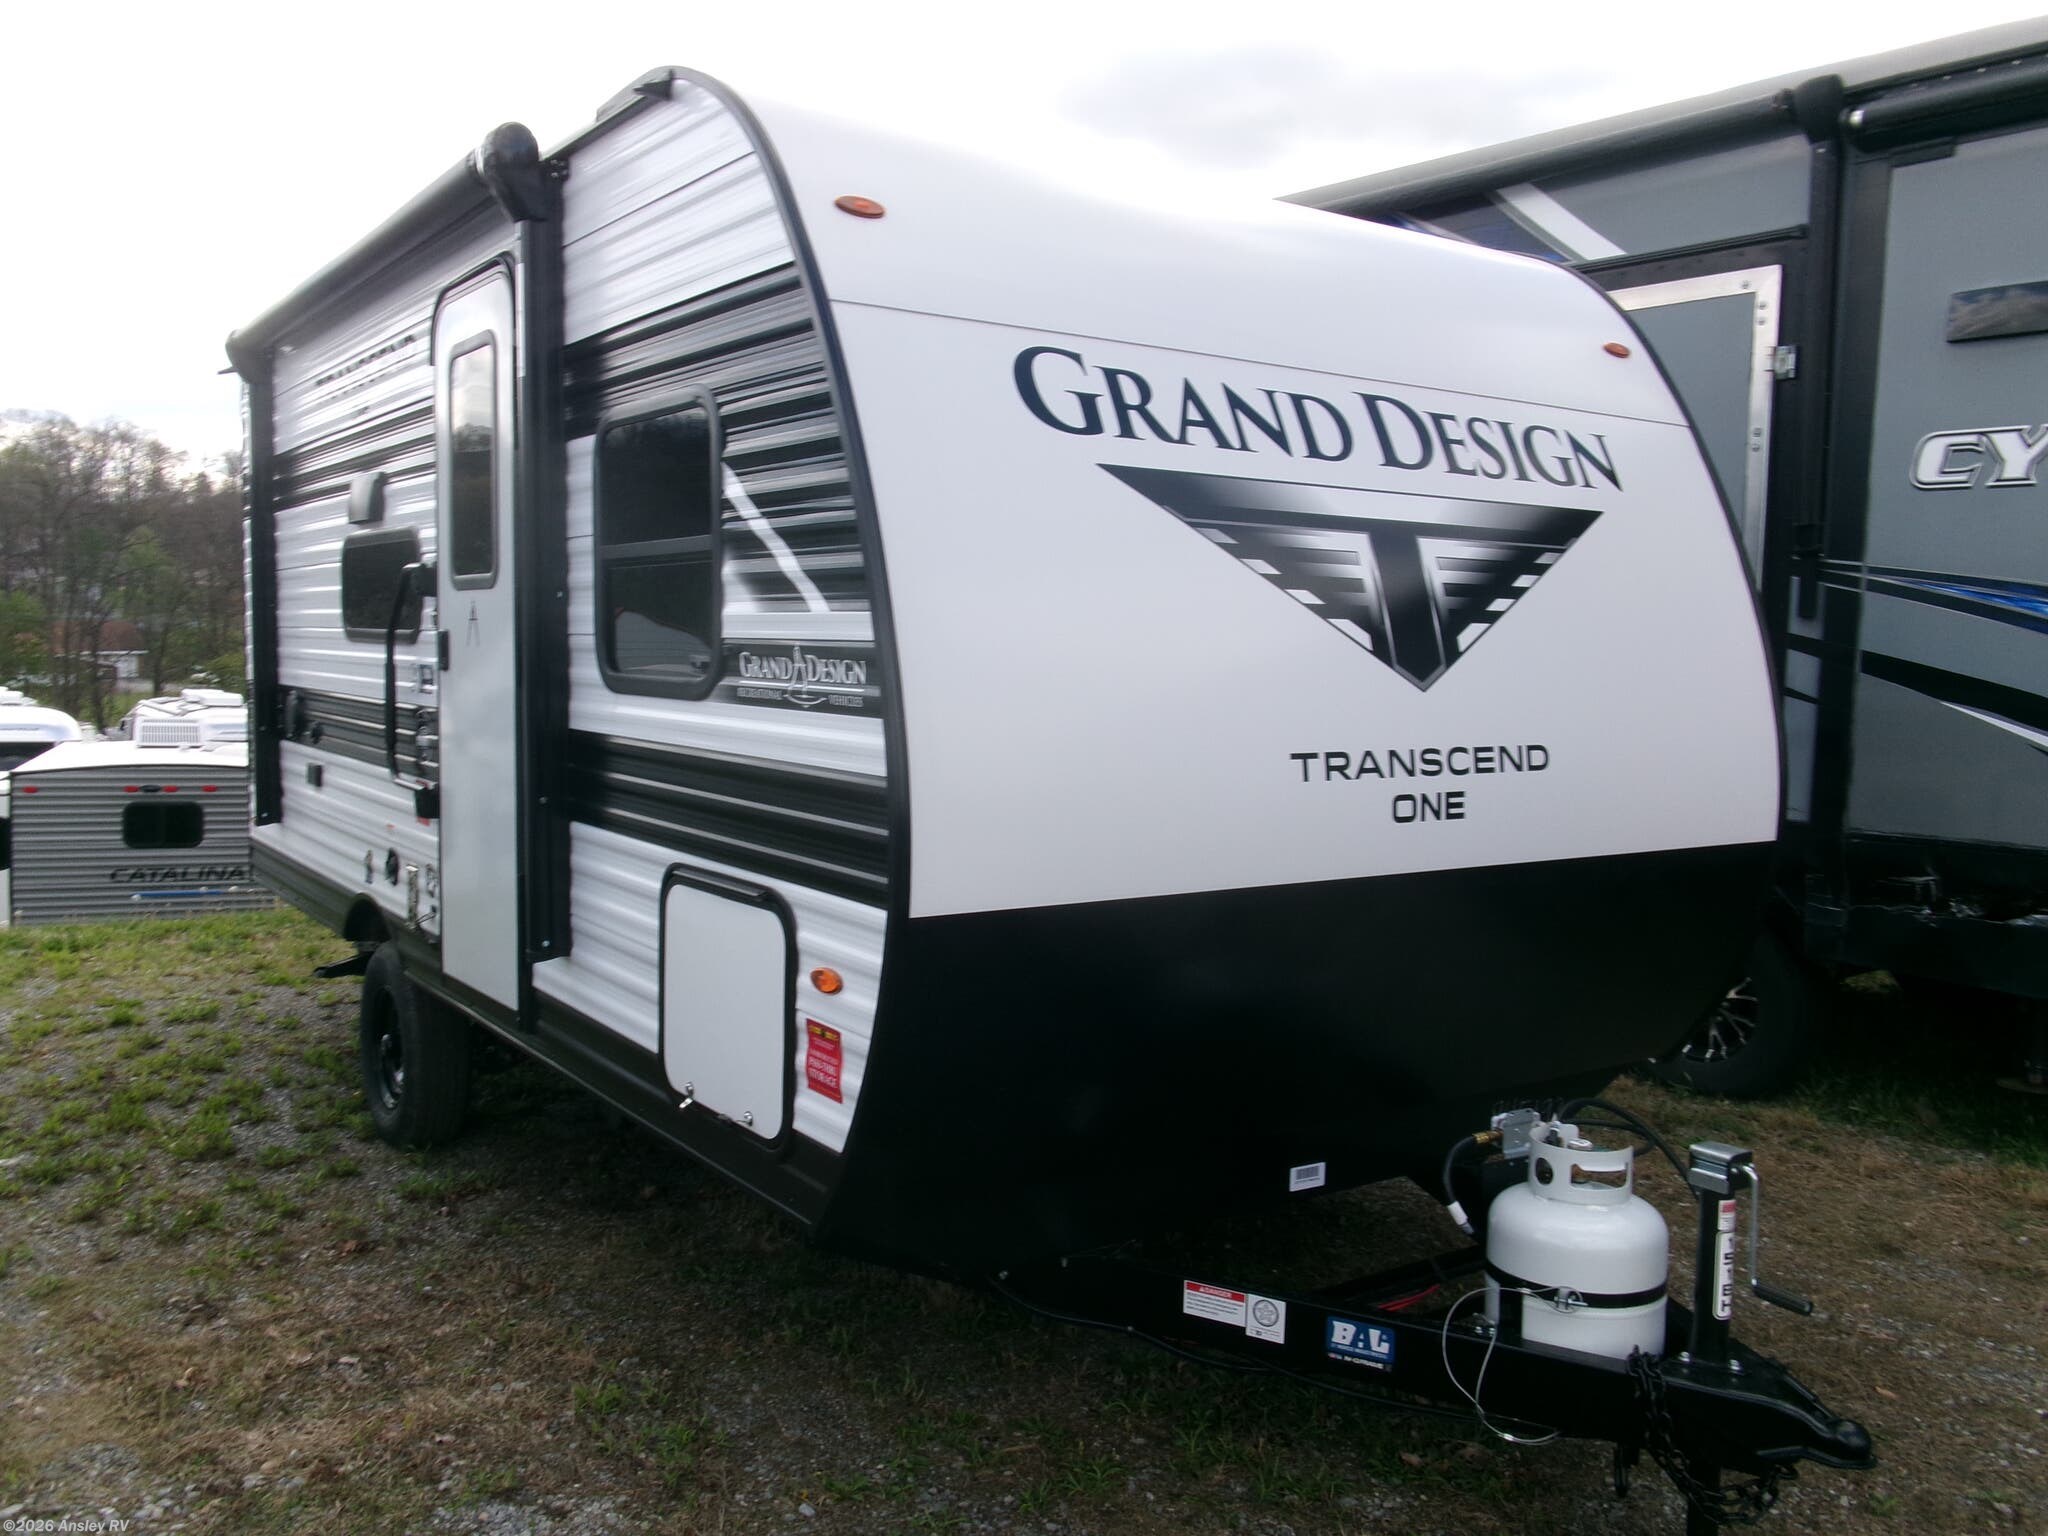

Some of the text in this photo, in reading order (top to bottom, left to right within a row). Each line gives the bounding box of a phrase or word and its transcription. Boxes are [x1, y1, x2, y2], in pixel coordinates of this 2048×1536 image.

[1013, 345, 1623, 492] GRAND DESIGN
[739, 651, 867, 685] GRAND DESIGN
[1290, 743, 1550, 782] TRANSCEND
[1391, 791, 1466, 823] ONE
[109, 866, 246, 882] CATALINA
